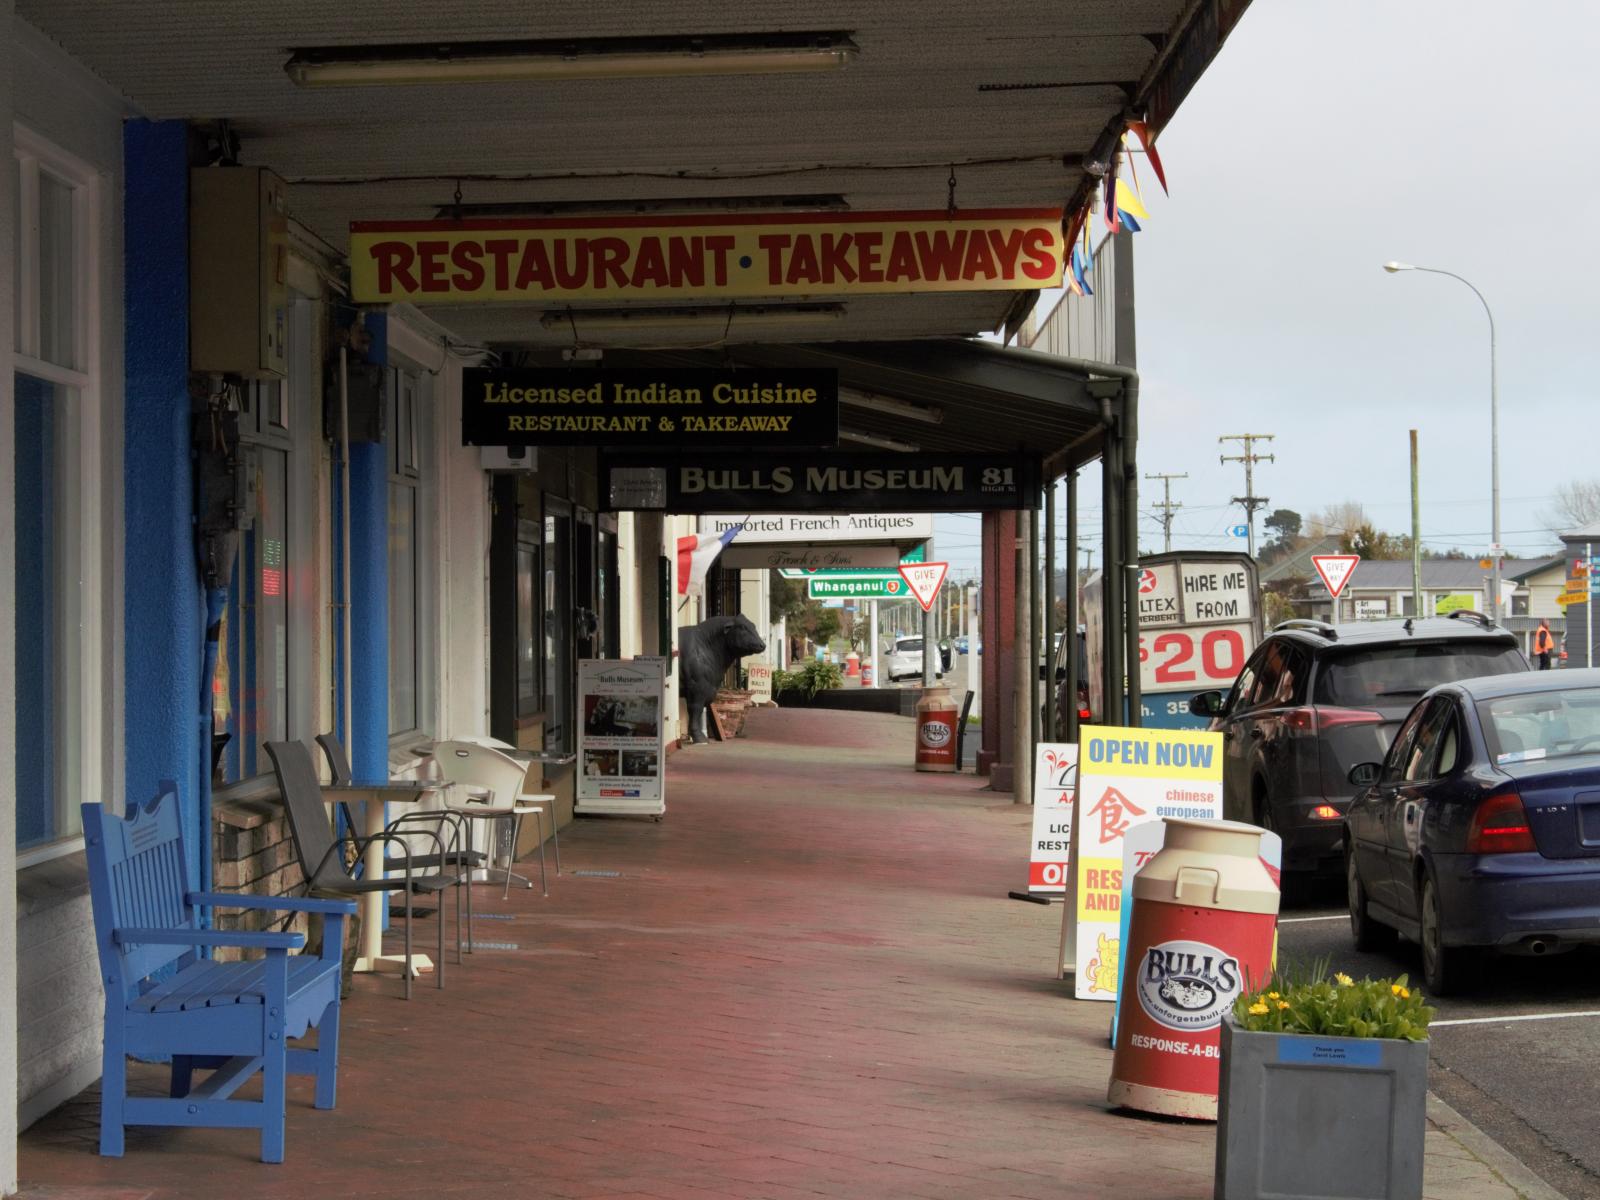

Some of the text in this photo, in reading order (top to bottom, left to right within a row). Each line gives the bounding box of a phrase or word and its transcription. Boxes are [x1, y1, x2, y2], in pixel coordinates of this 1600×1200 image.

[369, 228, 1056, 294] RESTAURANT TAKEAWAYS
[484, 382, 817, 404] Licensed Indian Cuisine
[508, 416, 792, 432] RESTAURANT & TAKEAWAY
[680, 467, 794, 494] BULLS
[806, 466, 964, 493] MUSEUM
[982, 467, 1013, 486] 81
[715, 515, 914, 532] Imported French Antiques
[1238, 527, 1245, 536] P
[914, 569, 936, 580] GIVE
[1326, 562, 1345, 572] GIVE
[814, 581, 884, 596] Whanganui
[919, 583, 932, 593] WAY
[1184, 572, 1246, 593] HIRE ME
[1140, 597, 1176, 613] LTEX
[1196, 599, 1238, 618] FROM
[751, 667, 770, 678] OPEN
[923, 723, 949, 736] BULLS
[1089, 738, 1214, 769] OPEN NOW
[1166, 789, 1215, 803] chinese
[1086, 785, 1147, 845] 食
[1156, 805, 1215, 819] european
[1085, 893, 1120, 911] AND
[1146, 948, 1237, 993] BULLS
